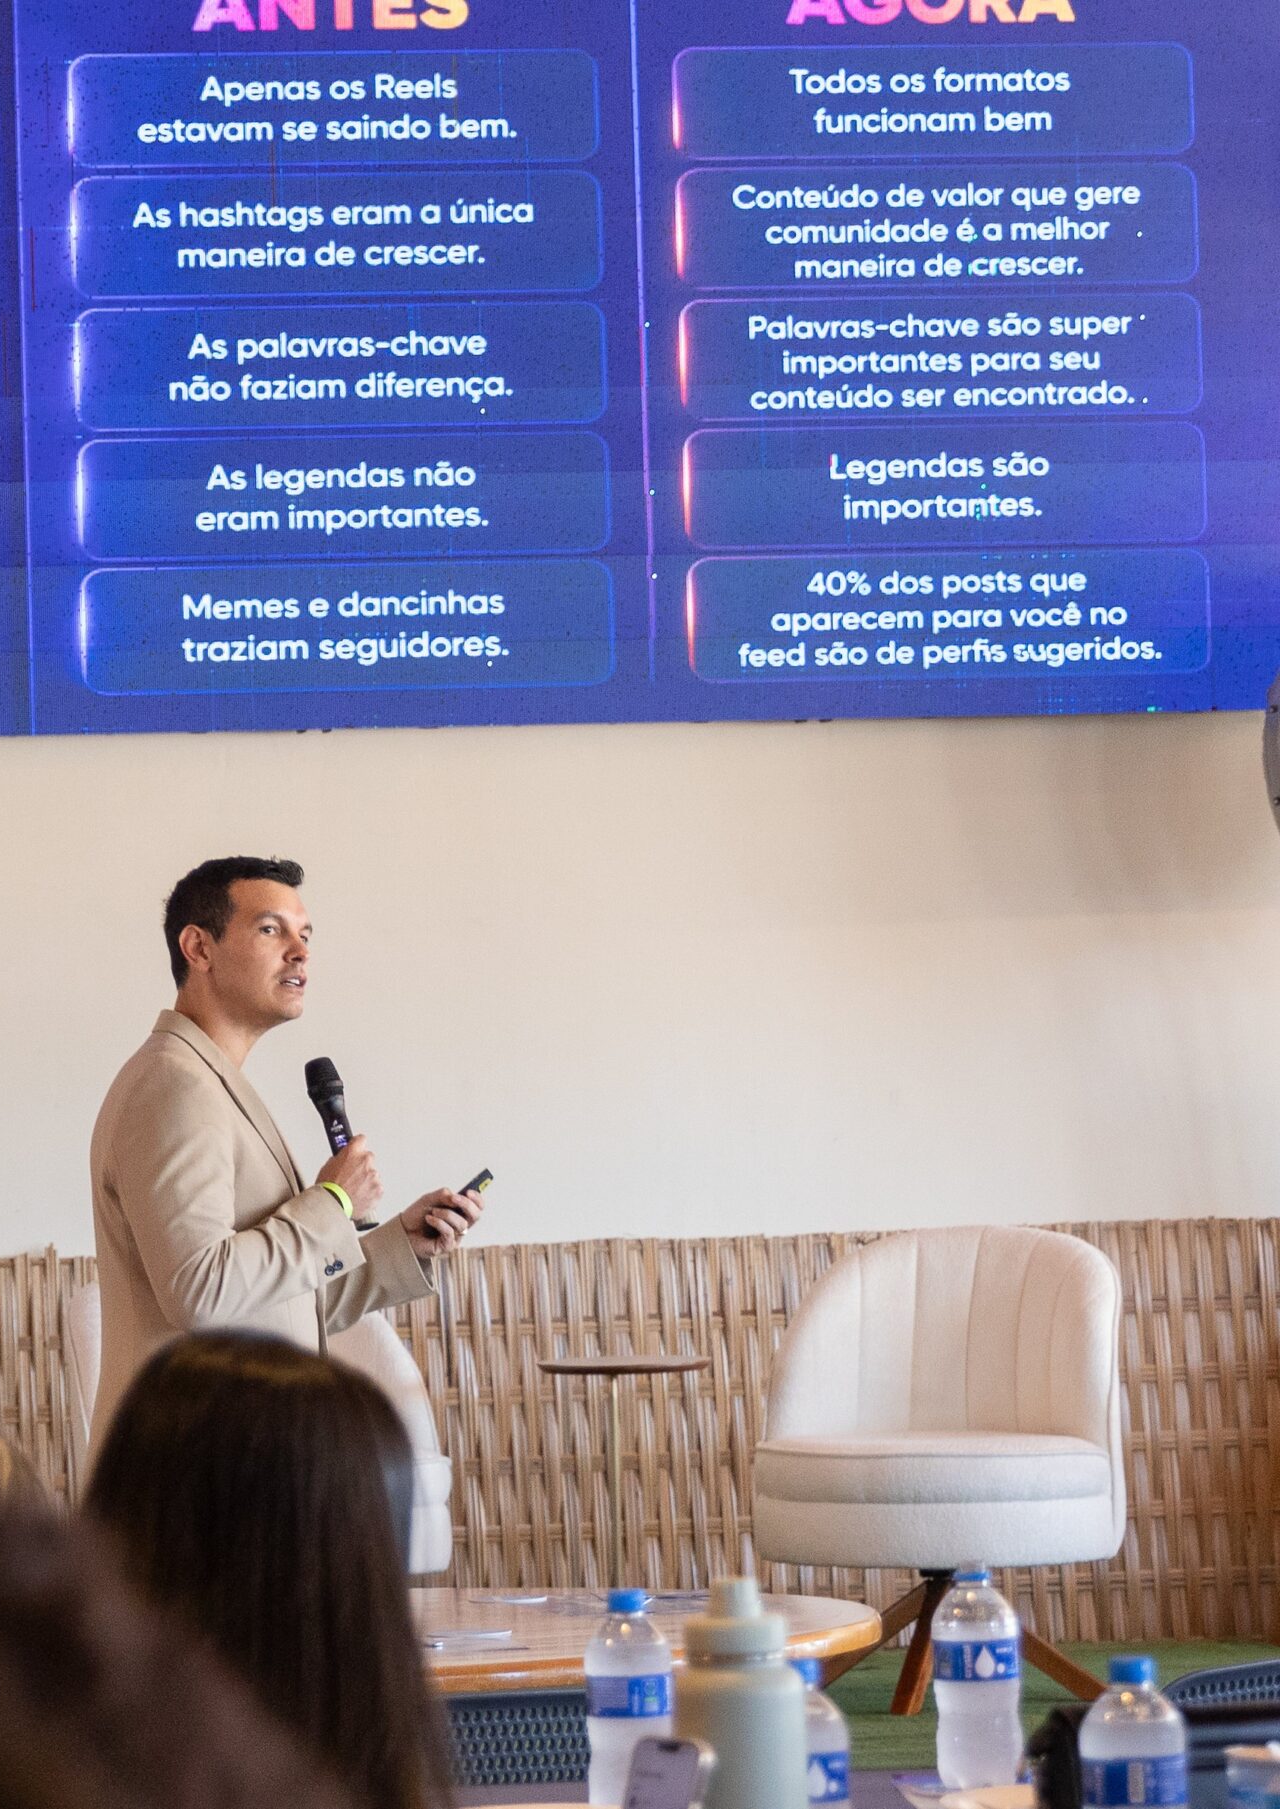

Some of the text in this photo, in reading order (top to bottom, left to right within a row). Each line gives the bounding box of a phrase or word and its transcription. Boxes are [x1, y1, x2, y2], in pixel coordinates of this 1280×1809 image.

[192, 0, 469, 31] ANTES
[201, 73, 458, 107] Apenas os Reels
[788, 66, 1070, 94] Todos os formatos
[137, 113, 517, 143] estavam se saindo bem.
[814, 106, 1052, 134] funcionam bem
[732, 182, 1141, 212] Conteúdo de valor que gere
[133, 198, 534, 232] As hashtags eram a única
[765, 215, 1111, 245] comunidade é a melhor
[177, 241, 485, 268] maneira de crescer.
[794, 253, 1084, 279] maneira de crescer.
[748, 312, 1132, 340] Palavras-chave são super
[188, 330, 487, 365] As palavras-chave
[782, 350, 1101, 380] importantes para seu
[169, 371, 513, 403] não faziam diferença.
[750, 379, 1135, 410] conteúdo ser encontrado.
[207, 461, 476, 496] As legendas não
[829, 451, 1050, 485] Legendas são
[195, 504, 489, 535] eram importantes.
[843, 494, 1042, 525] importantes.
[806, 570, 1087, 599] 40% dos posts que
[182, 590, 505, 620] Memes e dancinhas
[771, 601, 1128, 637] aparecem para você no
[181, 631, 509, 665] traziam seguidores.
[738, 636, 1162, 670] feed são de perfis sugeridos.
